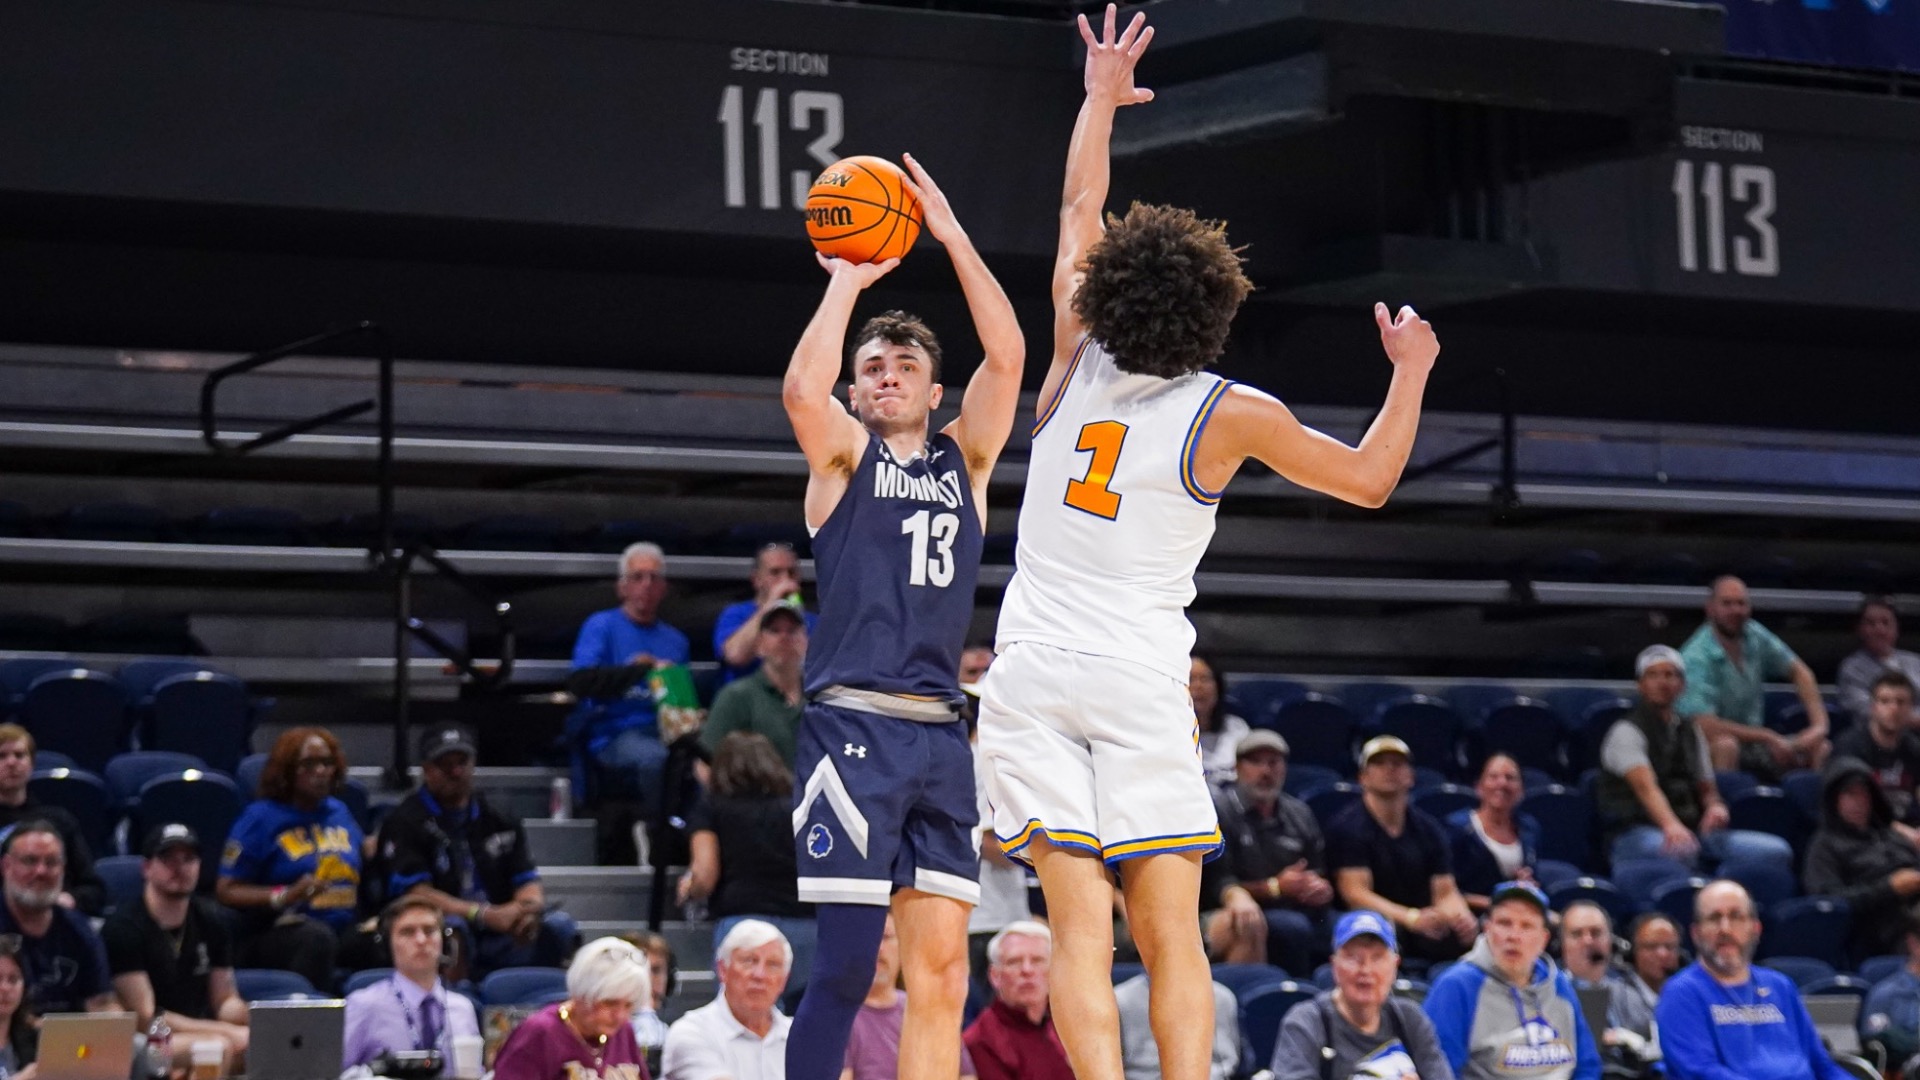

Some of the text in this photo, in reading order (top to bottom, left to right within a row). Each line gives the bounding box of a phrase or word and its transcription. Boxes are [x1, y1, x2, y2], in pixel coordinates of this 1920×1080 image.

[730, 47, 829, 76] SECTION
[717, 84, 844, 210] 113
[1680, 125, 1764, 152] SECTION
[1671, 159, 1780, 276] 113
[1063, 420, 1130, 521] 1
[902, 510, 960, 588] 13
